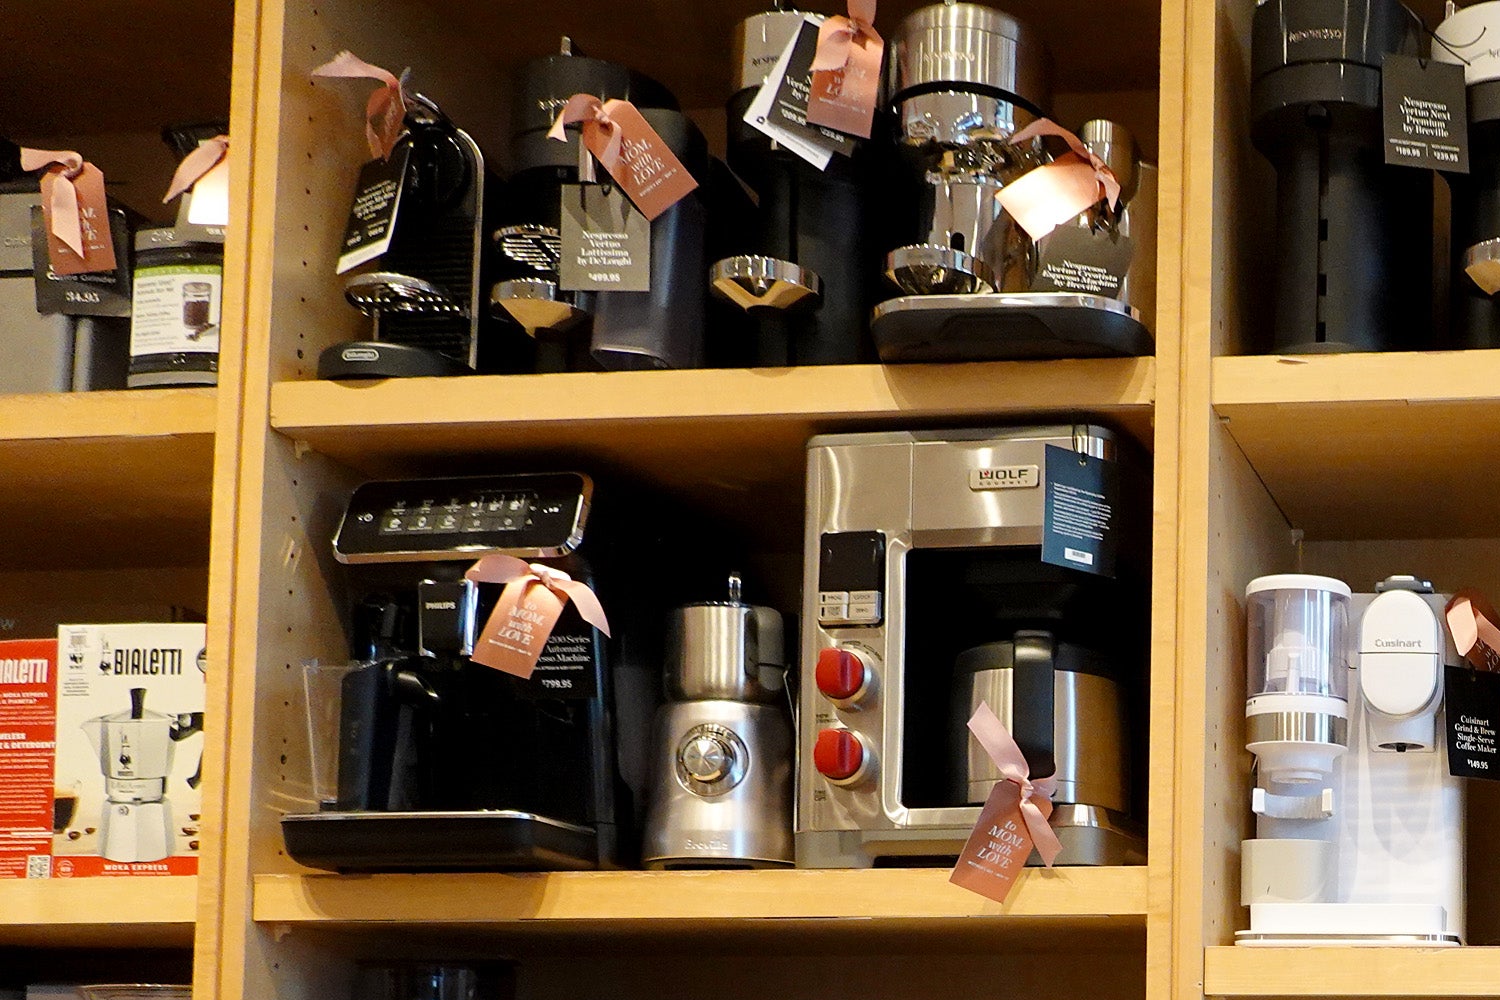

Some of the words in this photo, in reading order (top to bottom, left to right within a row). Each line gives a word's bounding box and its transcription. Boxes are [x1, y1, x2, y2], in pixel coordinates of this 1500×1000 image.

[1403, 95, 1447, 111] Nespresso
[1400, 104, 1429, 117] Vertuo
[1430, 109, 1451, 120] Next
[1406, 115, 1446, 128] Premium
[1403, 122, 1413, 135] by
[1415, 125, 1449, 138] Breville
[582, 231, 629, 242] Nespresso
[589, 239, 621, 249] Vertuo
[581, 248, 629, 257] Lattissima
[577, 256, 587, 266] by
[979, 469, 1028, 480] WOLF
[425, 602, 456, 610] PHILIPS
[1375, 639, 1422, 648] Cuisinart
[1460, 715, 1490, 726] Cuisinart
[1454, 723, 1473, 734] Grind
[1480, 727, 1496, 736] Brew
[1457, 733, 1495, 745] Single-Serve
[1455, 741, 1477, 752] Coffee
[1477, 744, 1497, 754] Maker
[1467, 759, 1489, 770] $149.95
[1005, 820, 1017, 831] to
[988, 841, 1012, 856] with
[976, 847, 1013, 869] LOVE
